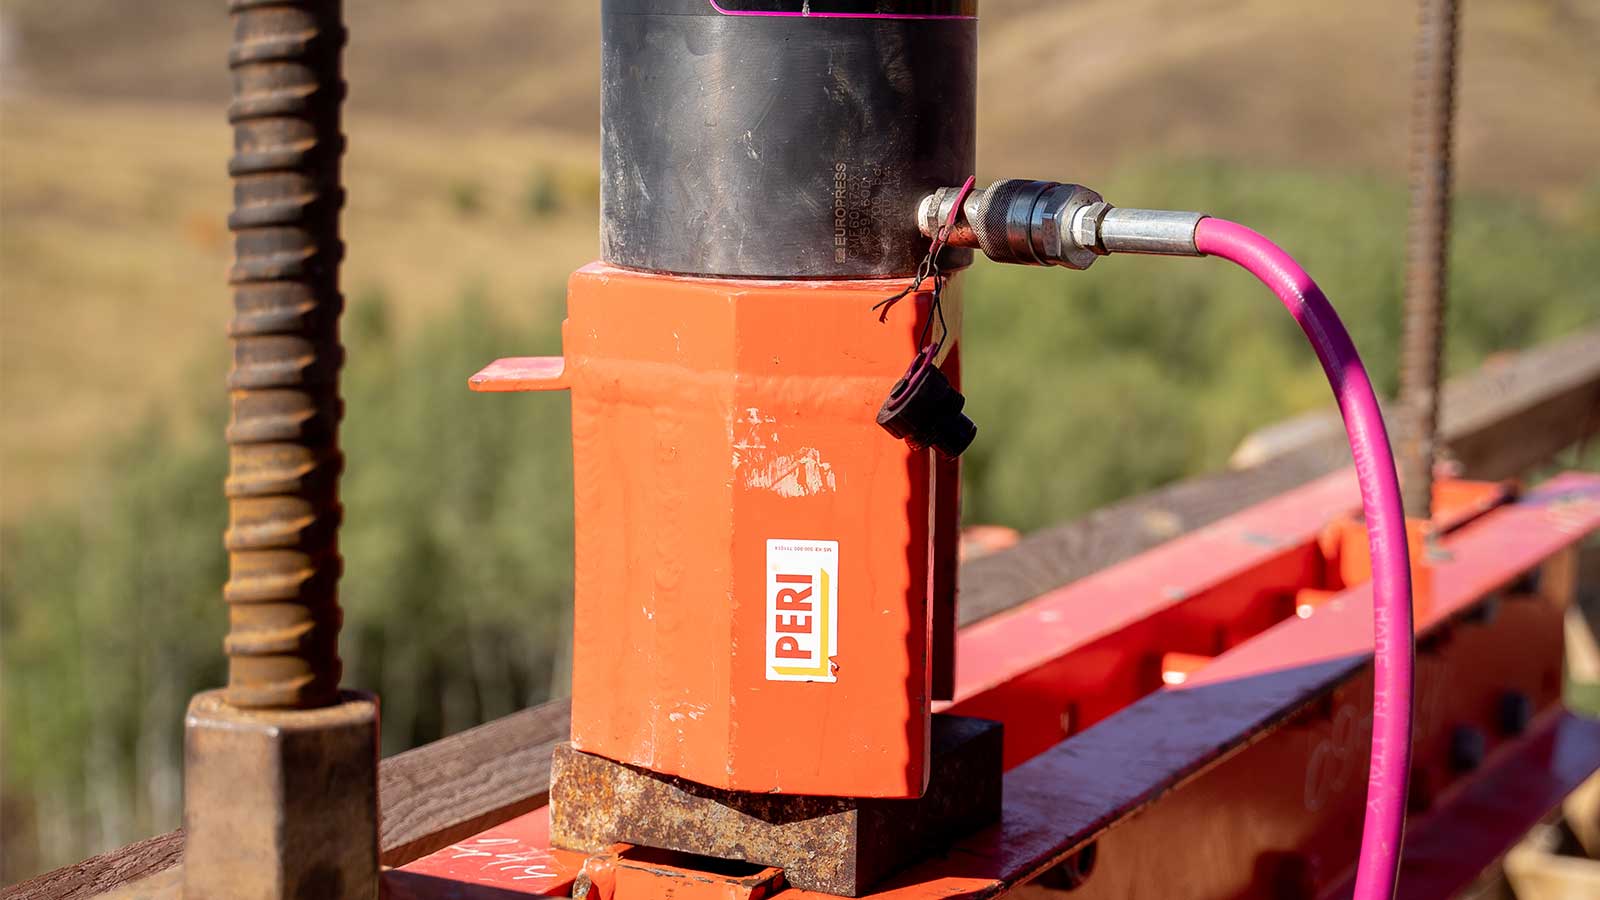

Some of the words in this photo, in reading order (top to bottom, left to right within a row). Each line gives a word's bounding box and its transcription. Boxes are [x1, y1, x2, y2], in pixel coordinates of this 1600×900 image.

[834, 162, 847, 246] EUROPRESS
[775, 573, 812, 659] PERI
[1375, 607, 1389, 667] MADE
